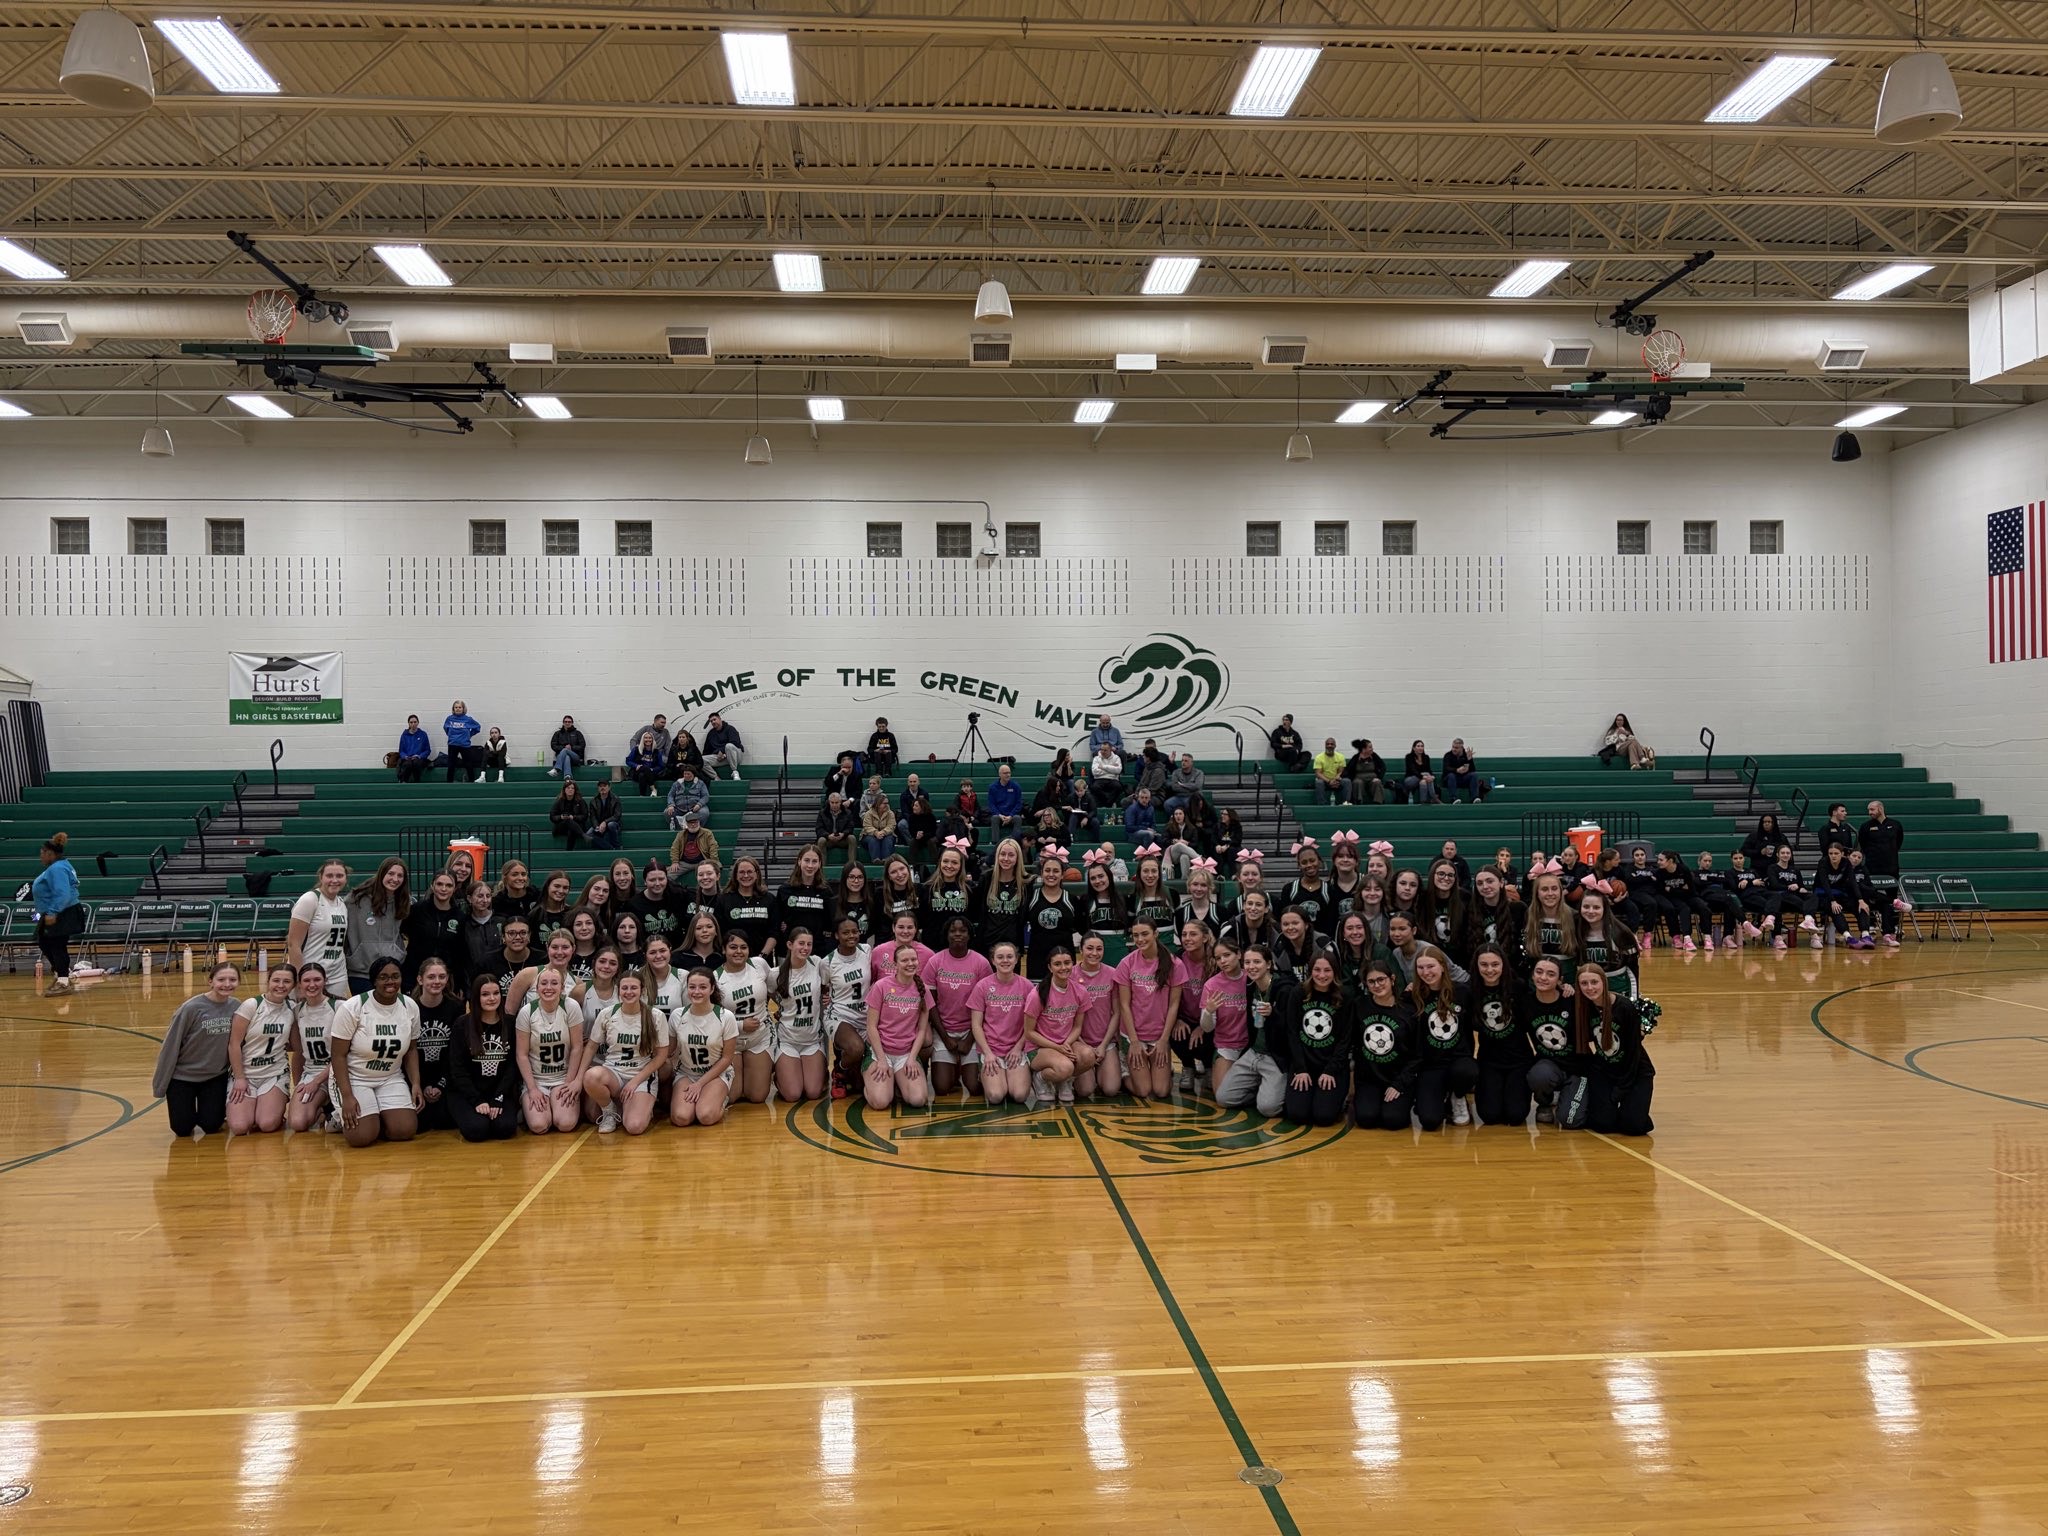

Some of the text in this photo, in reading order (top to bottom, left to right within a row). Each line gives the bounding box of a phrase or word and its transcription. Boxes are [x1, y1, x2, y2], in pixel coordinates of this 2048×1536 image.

[252, 673, 321, 692] Hurst
[678, 668, 1102, 731] HOME OF THE GREEN WAVE
[281, 712, 337, 720] BASKETBALL
[326, 927, 346, 947] 33
[844, 968, 863, 983] HOLY
[732, 985, 754, 1001] HOLY
[792, 982, 811, 996] HOLY
[852, 982, 862, 1000] 3
[735, 998, 756, 1015] 21
[795, 996, 813, 1015] 14
[792, 1016, 814, 1028] NAME
[1362, 1014, 1400, 1031] HOLY NAME
[1531, 1014, 1568, 1027] HOLY NAME
[263, 1023, 285, 1034] HOLY
[305, 1026, 324, 1038] HOLY
[376, 1024, 398, 1036] HOLY
[540, 1031, 562, 1043] HOLY
[617, 1032, 640, 1045] HOLY
[687, 1033, 709, 1046] HOLY
[265, 1036, 275, 1055] 1
[306, 1040, 330, 1060] 10
[371, 1038, 402, 1060] 42
[539, 1043, 565, 1063] 20
[251, 1055, 276, 1067] NAME
[621, 1046, 635, 1061] 5
[689, 1047, 710, 1065] 12
[366, 1059, 394, 1072] NAME
[541, 1063, 565, 1074] NAME
